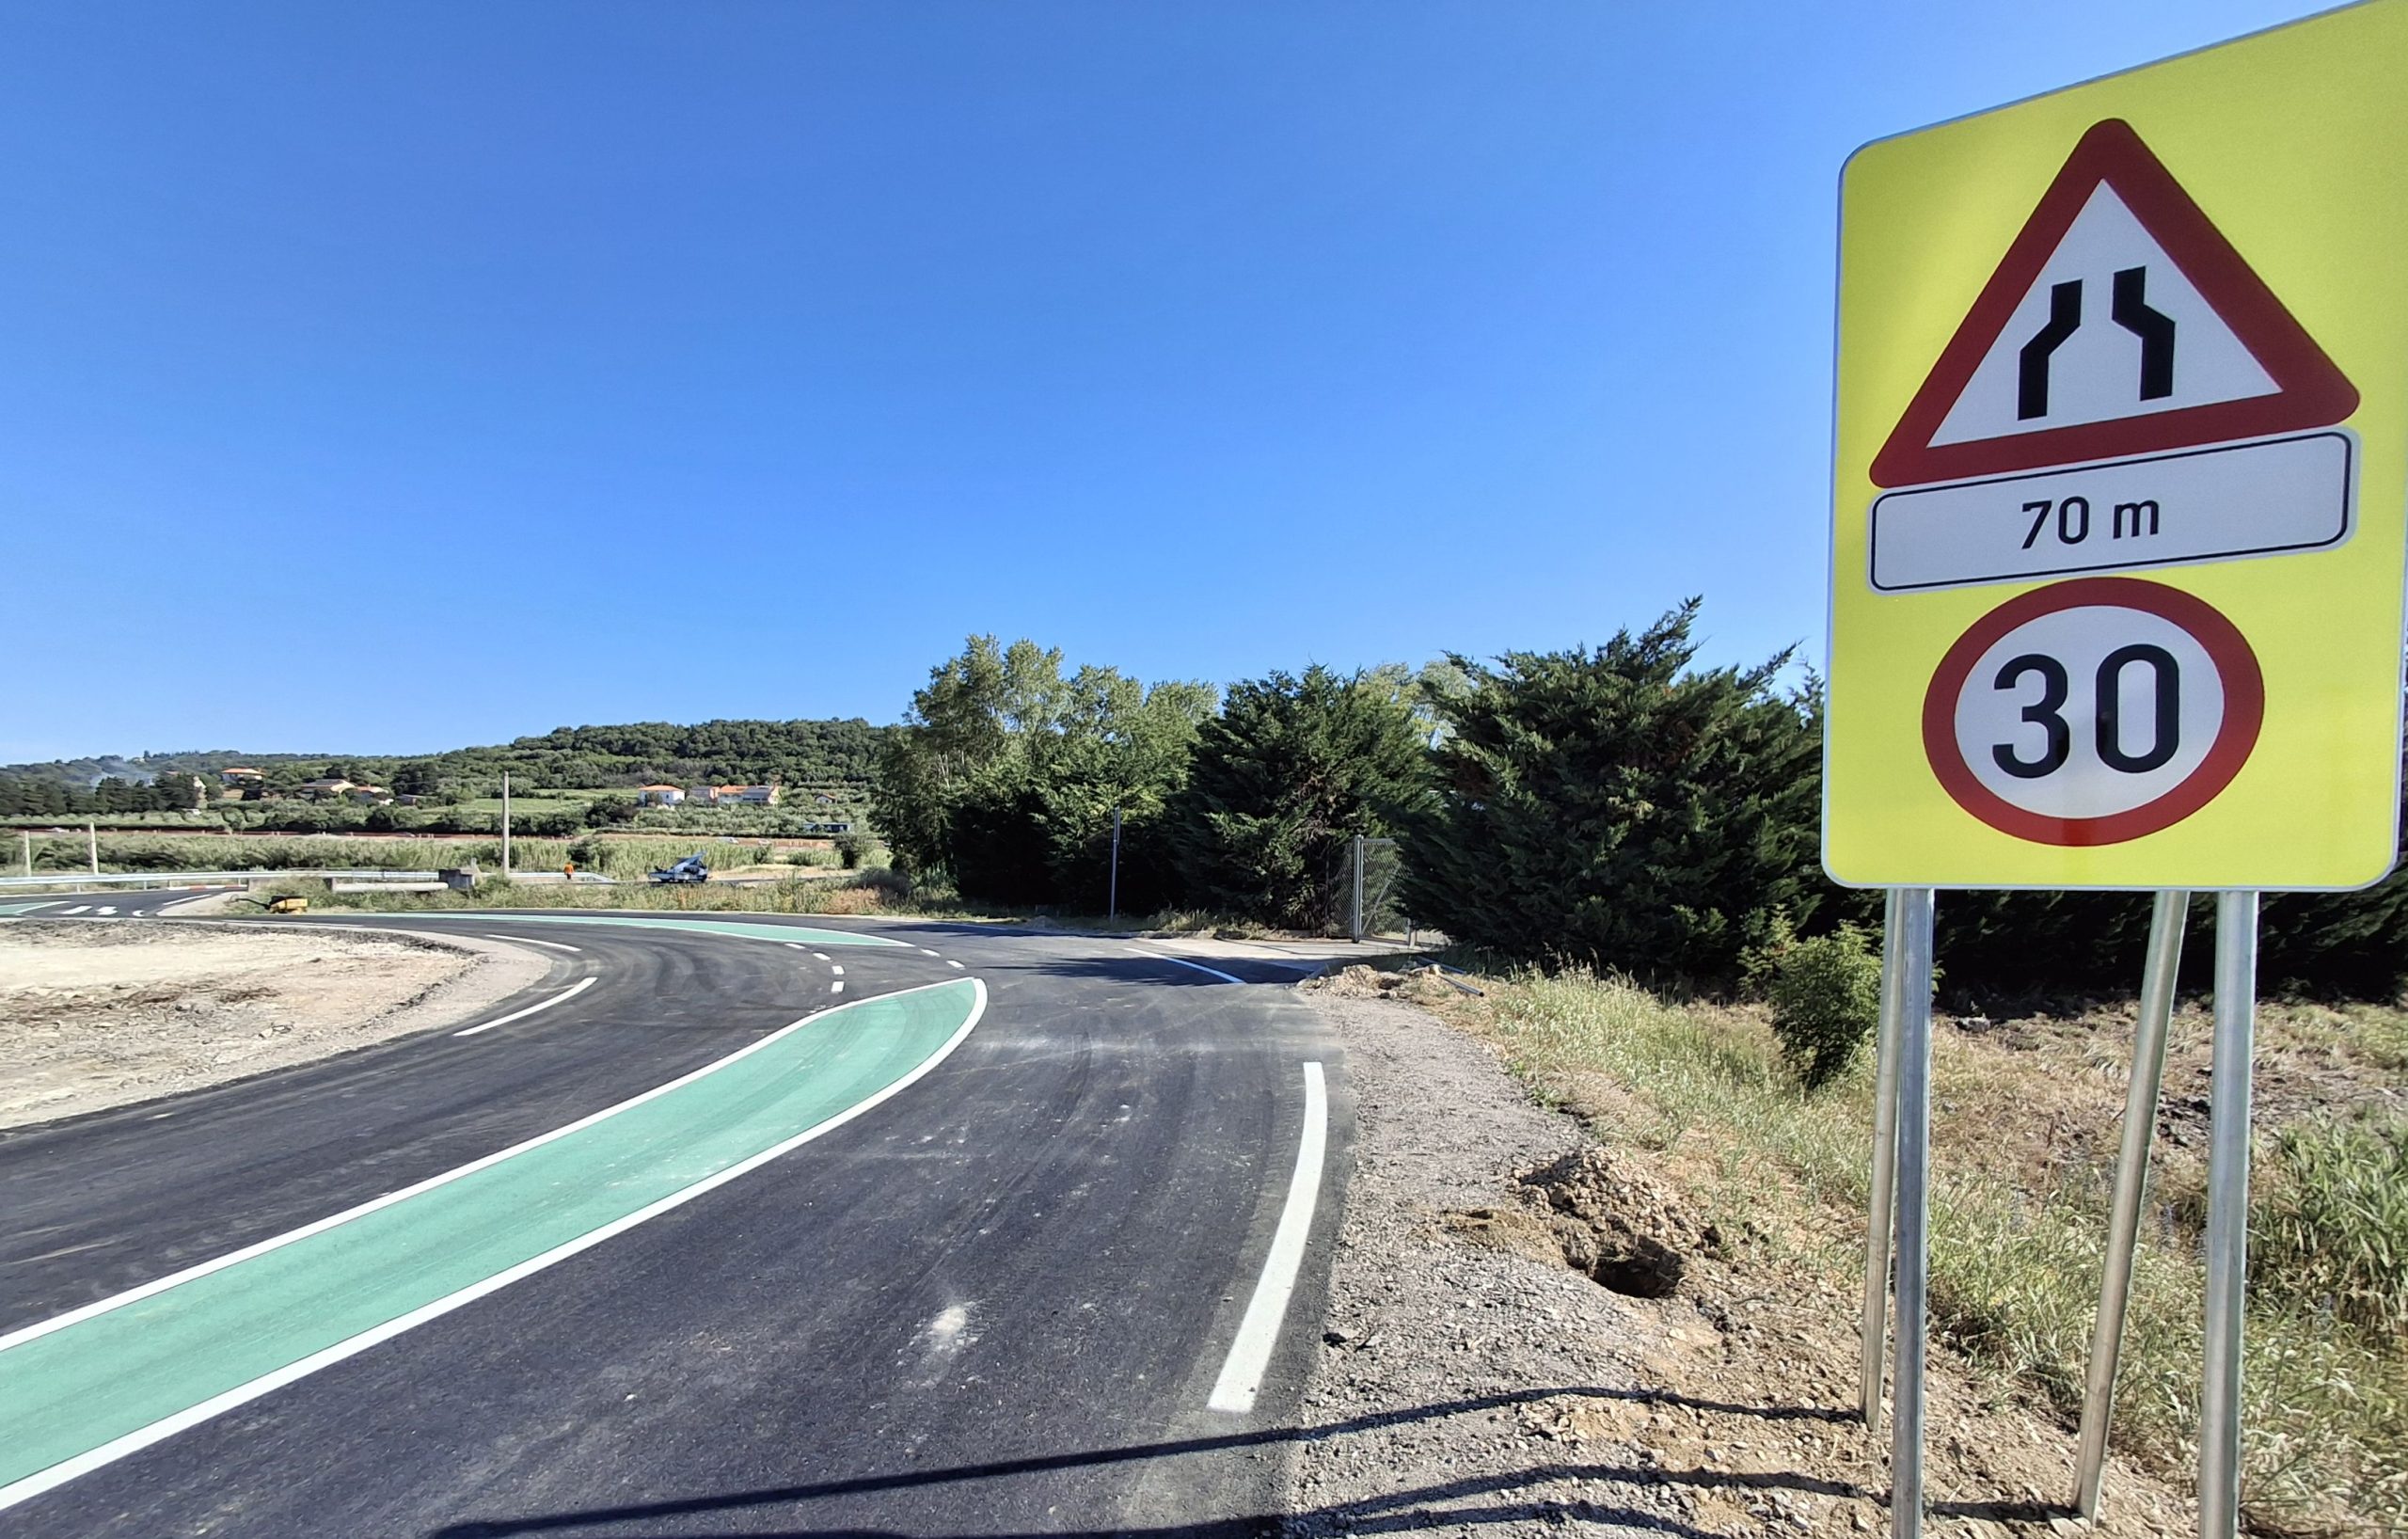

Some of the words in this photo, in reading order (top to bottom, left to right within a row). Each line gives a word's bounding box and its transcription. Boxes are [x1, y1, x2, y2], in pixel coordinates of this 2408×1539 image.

[2020, 496, 2090, 550] 70
[2113, 500, 2160, 540] m
[1991, 643, 2180, 779] 30
